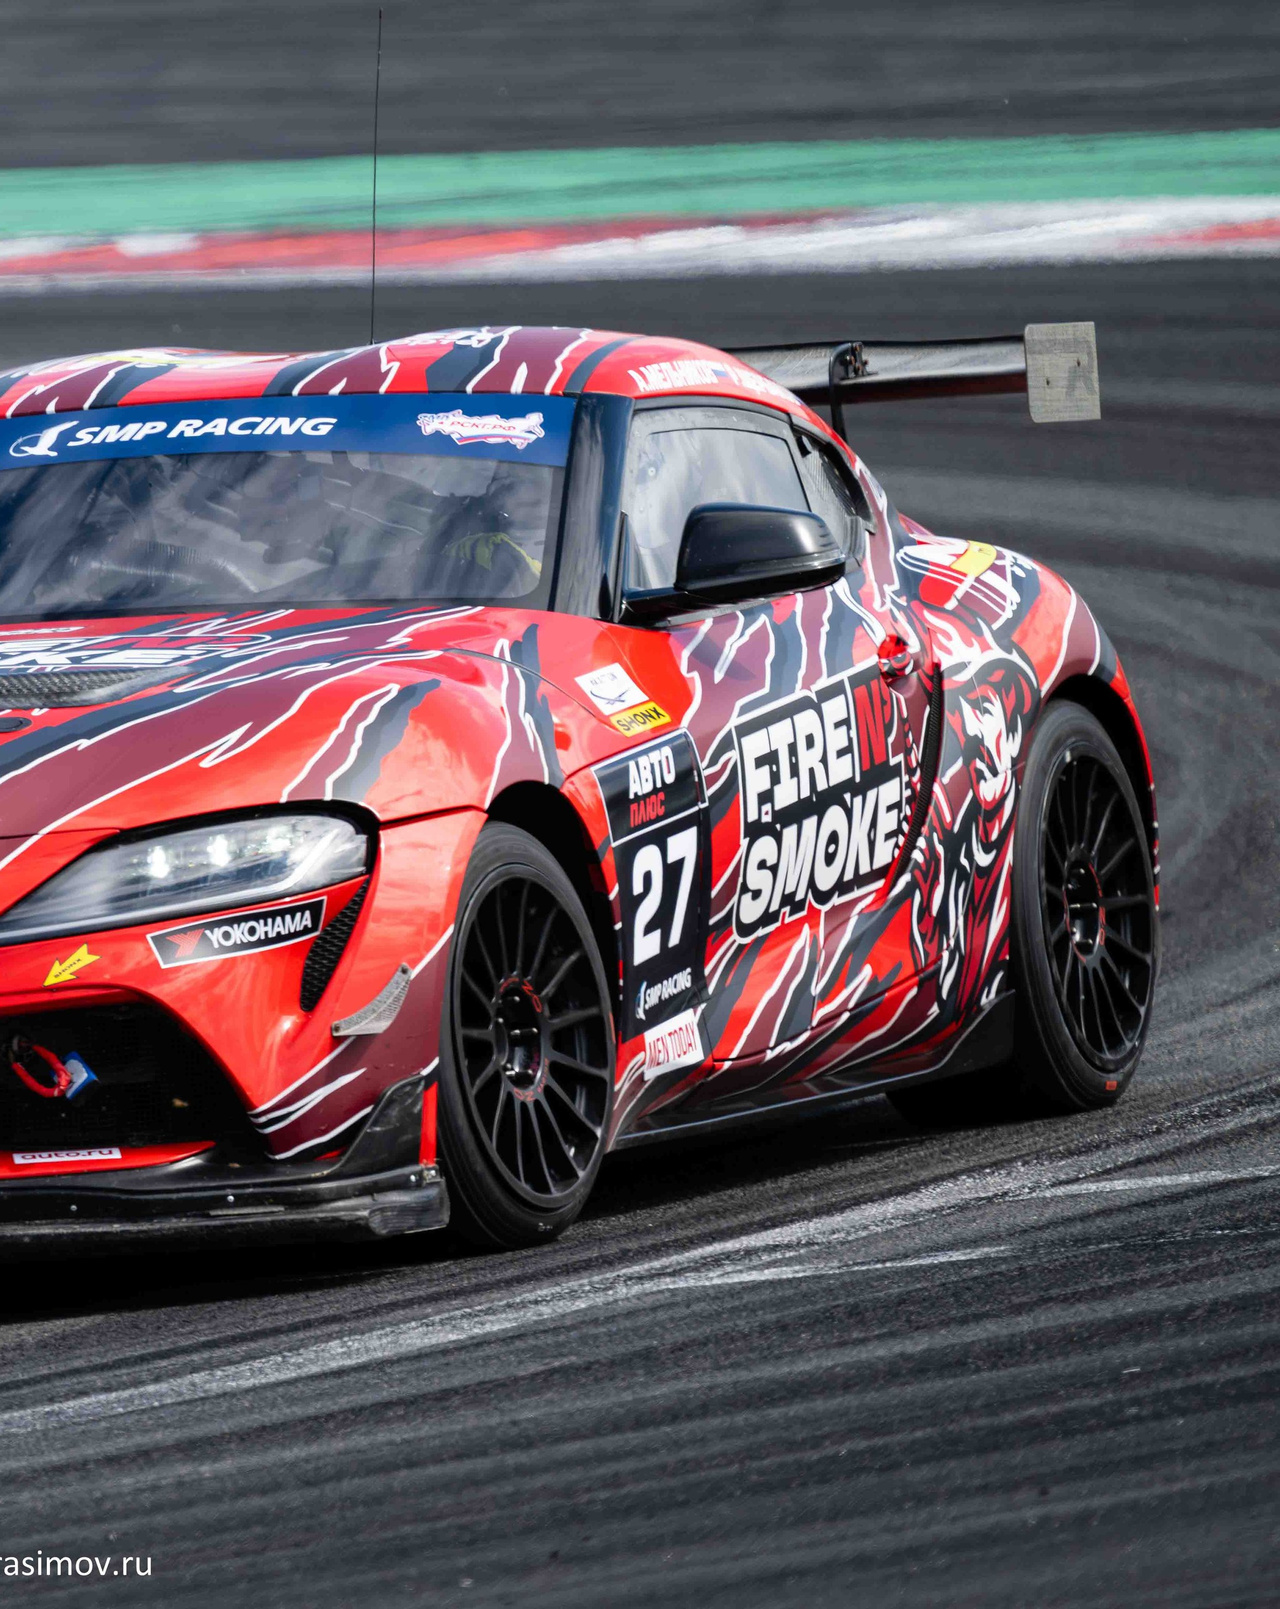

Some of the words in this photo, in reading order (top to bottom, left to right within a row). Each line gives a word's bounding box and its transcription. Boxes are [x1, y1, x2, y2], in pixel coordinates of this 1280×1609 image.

[67, 421, 167, 446] SMP
[167, 417, 337, 438] RACING
[616, 706, 665, 731] SHONX
[628, 745, 676, 799] АВТО
[740, 694, 854, 823] FIRE
[629, 791, 666, 828] ПЛЮС
[739, 777, 902, 924] SMOKE
[632, 826, 698, 966] 27
[204, 910, 312, 949] YOKOHAMA
[645, 983, 661, 1010] SMP
[661, 967, 692, 1001] RACING
[646, 1034, 670, 1070] MEN
[668, 1021, 698, 1061] TODAY
[21, 1149, 113, 1160] auto.ru
